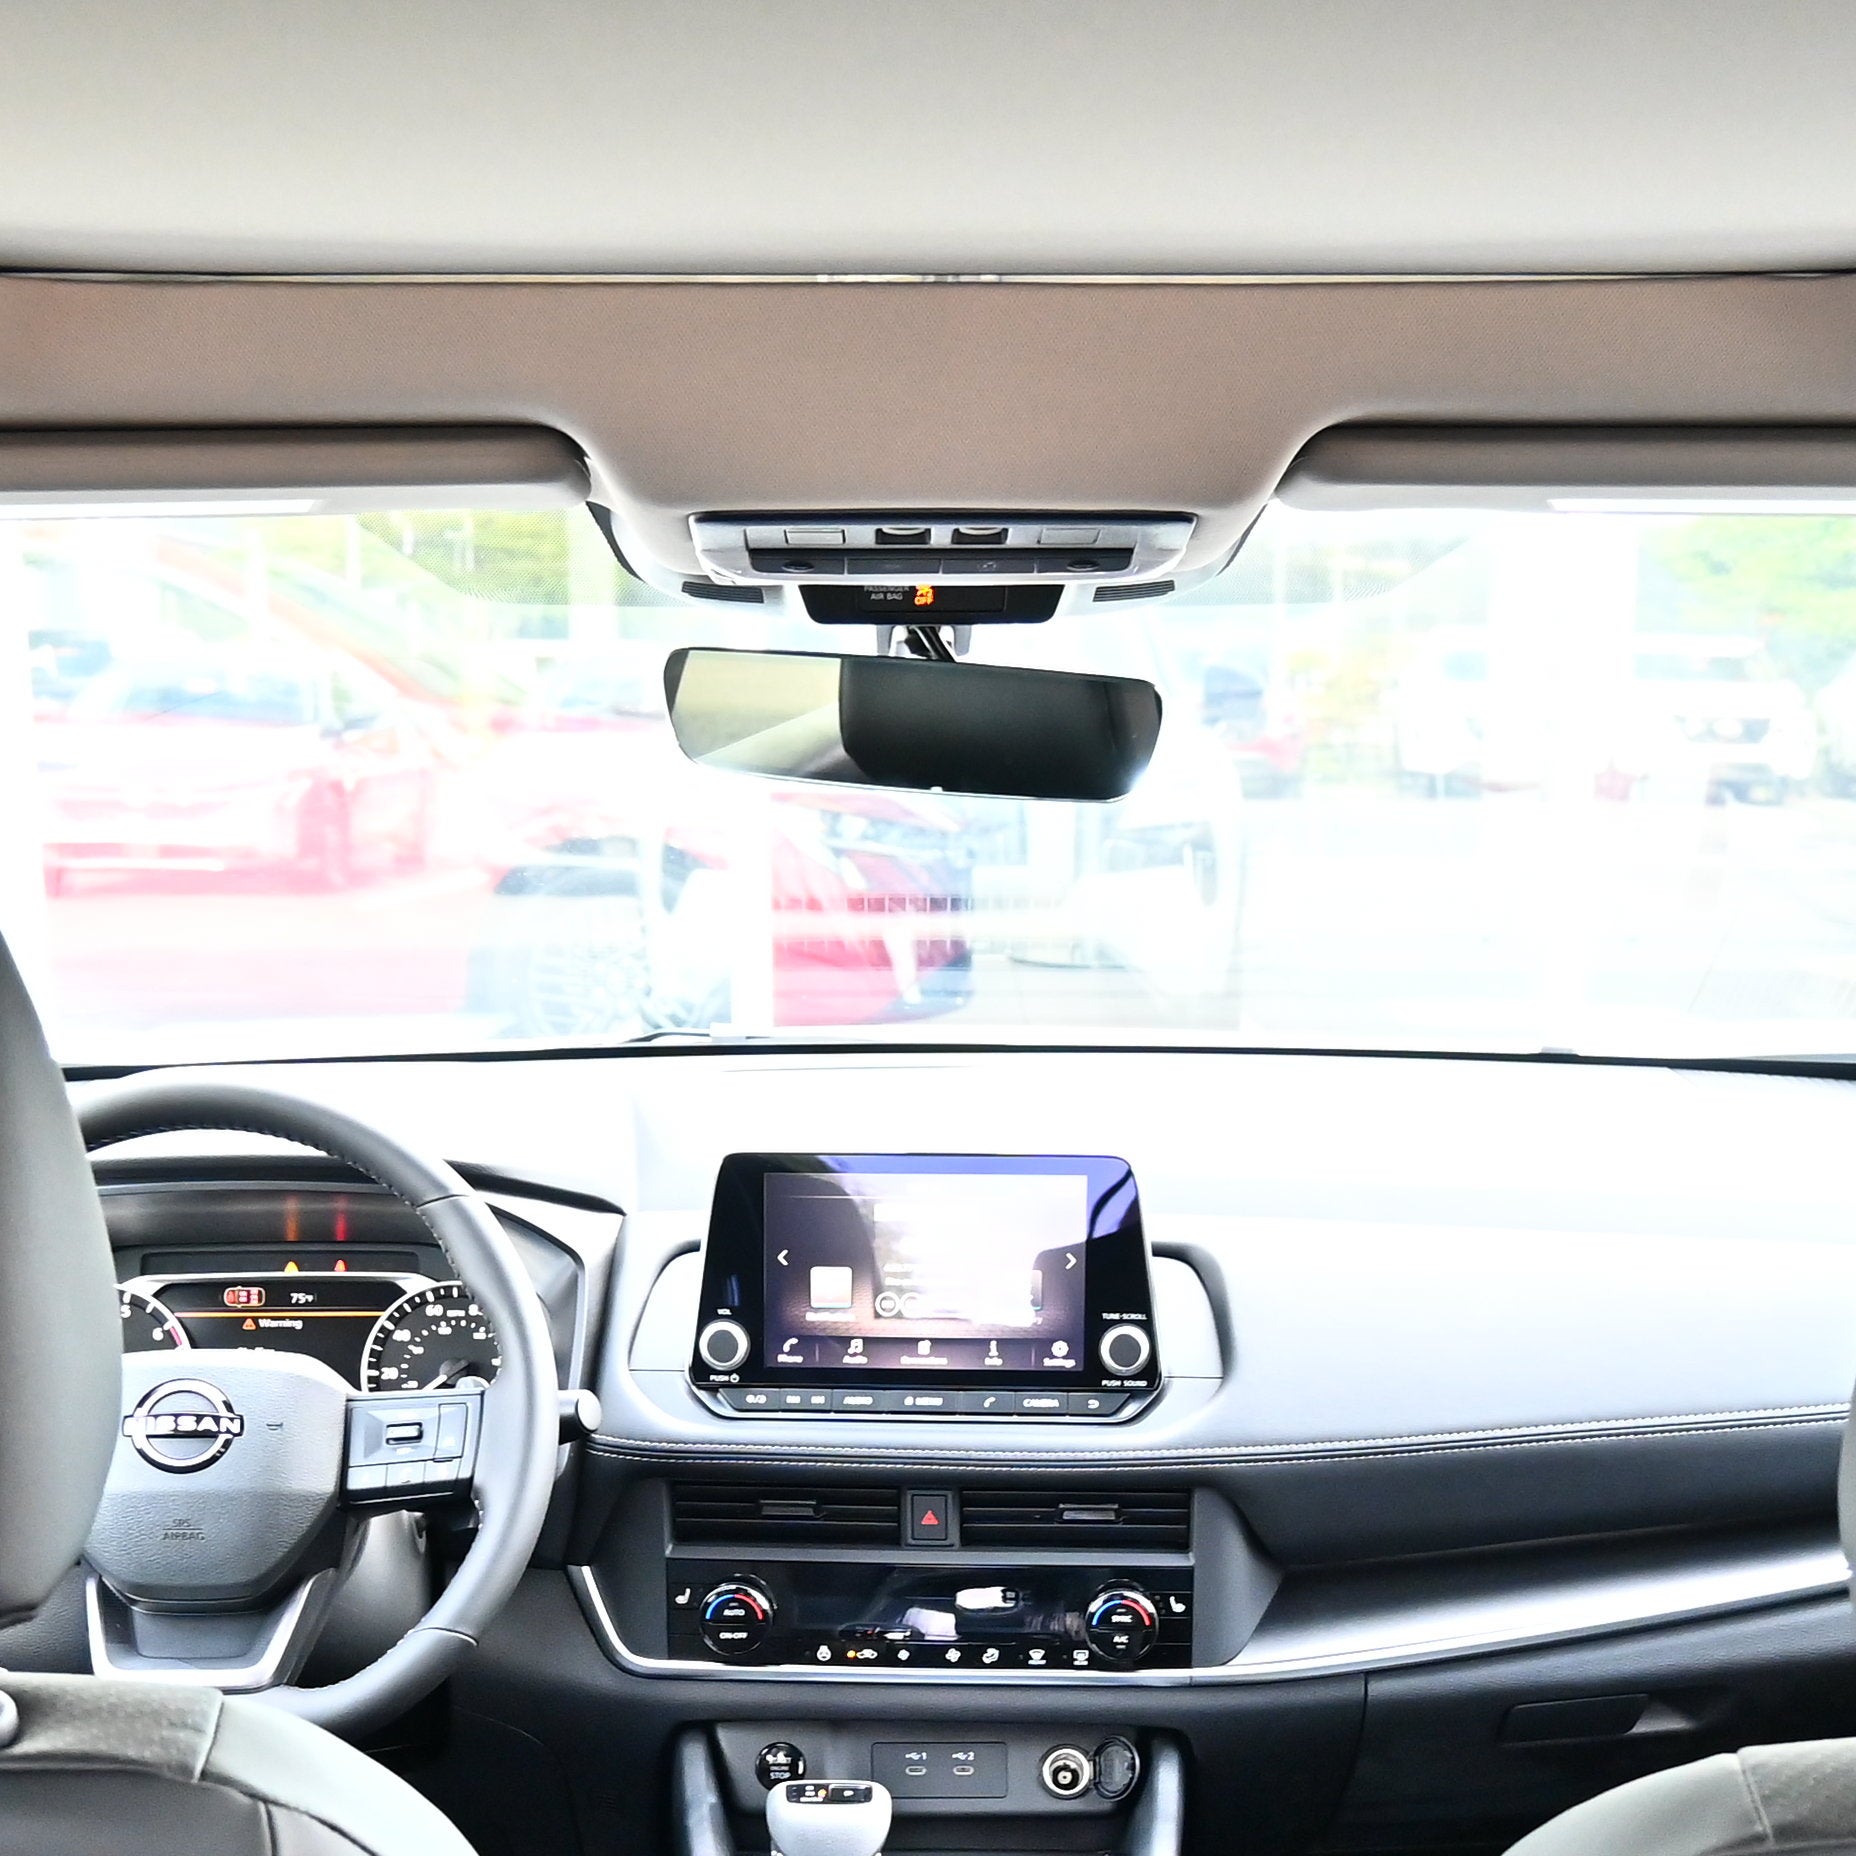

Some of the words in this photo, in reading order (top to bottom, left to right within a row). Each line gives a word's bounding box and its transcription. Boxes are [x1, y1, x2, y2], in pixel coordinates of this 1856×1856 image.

[870, 592, 884, 600] AIR
[886, 592, 904, 600] BAG
[120, 1305, 131, 1318] 5
[425, 1304, 444, 1317] 60
[716, 1308, 732, 1316] VOL
[258, 1318, 304, 1330] Warning
[152, 1327, 164, 1341] 6
[392, 1329, 411, 1342] 40
[380, 1367, 399, 1380] 20
[709, 1374, 730, 1382] PUSH
[1101, 1379, 1122, 1387] PUSH
[1124, 1379, 1148, 1387] SOUND
[1022, 1398, 1060, 1408] CAMERA
[125, 1415, 242, 1434] NISSAN
[769, 1771, 792, 1780] STOP
